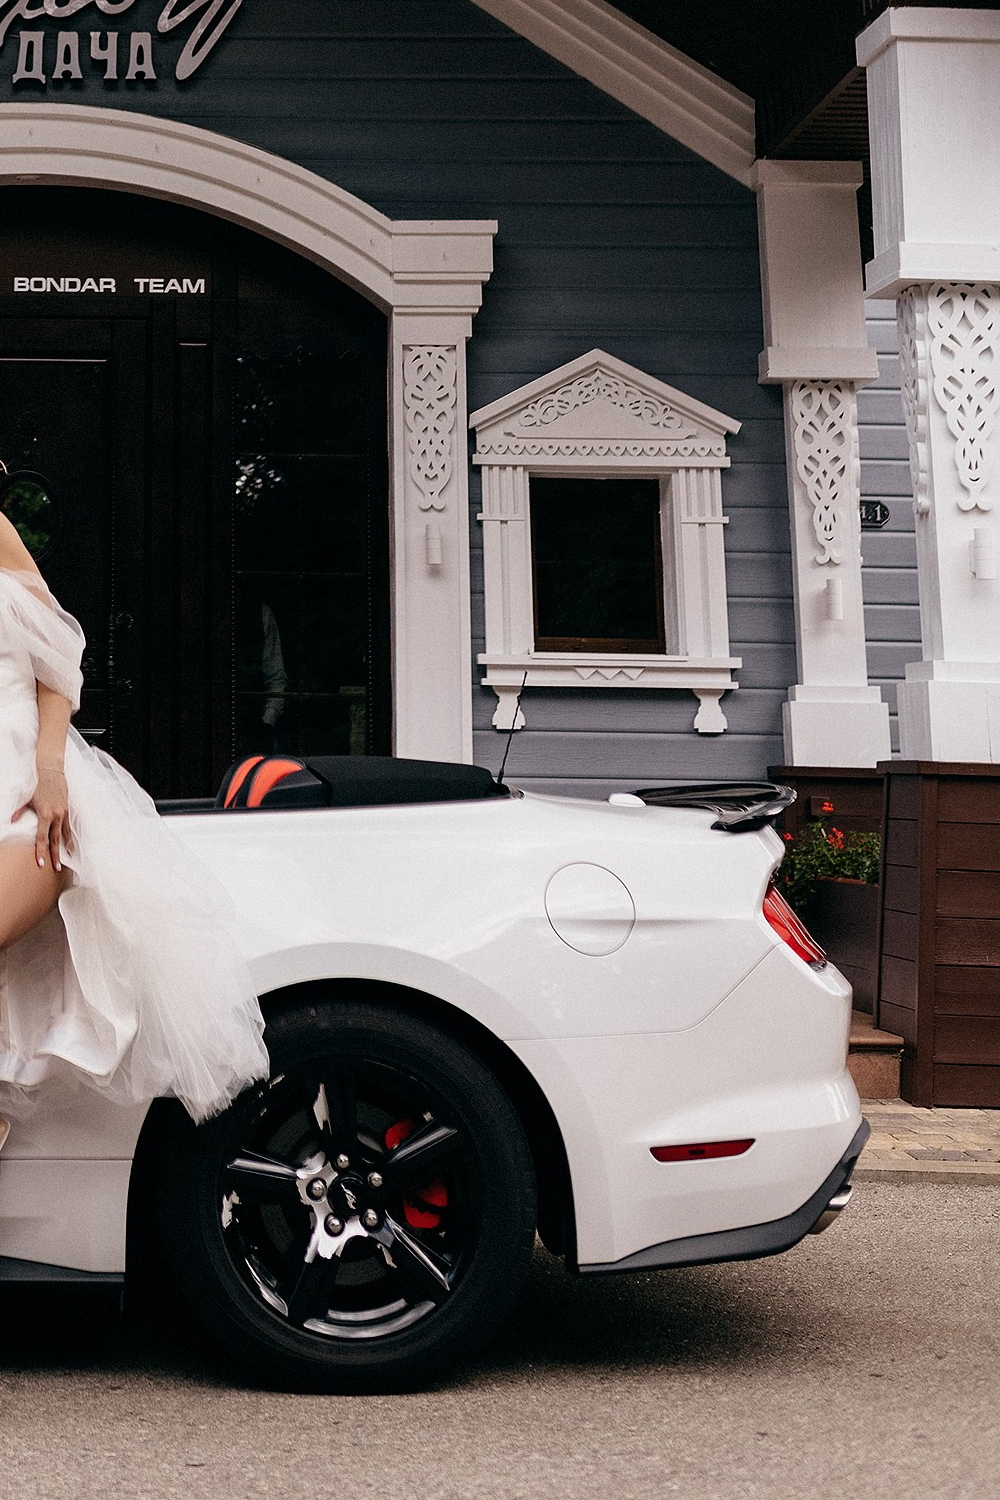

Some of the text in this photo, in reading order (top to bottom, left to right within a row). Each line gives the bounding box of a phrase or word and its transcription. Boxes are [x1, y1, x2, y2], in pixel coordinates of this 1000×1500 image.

[12, 30, 157, 84] ДАЧА
[13, 277, 205, 294] BONDAR TEAM
